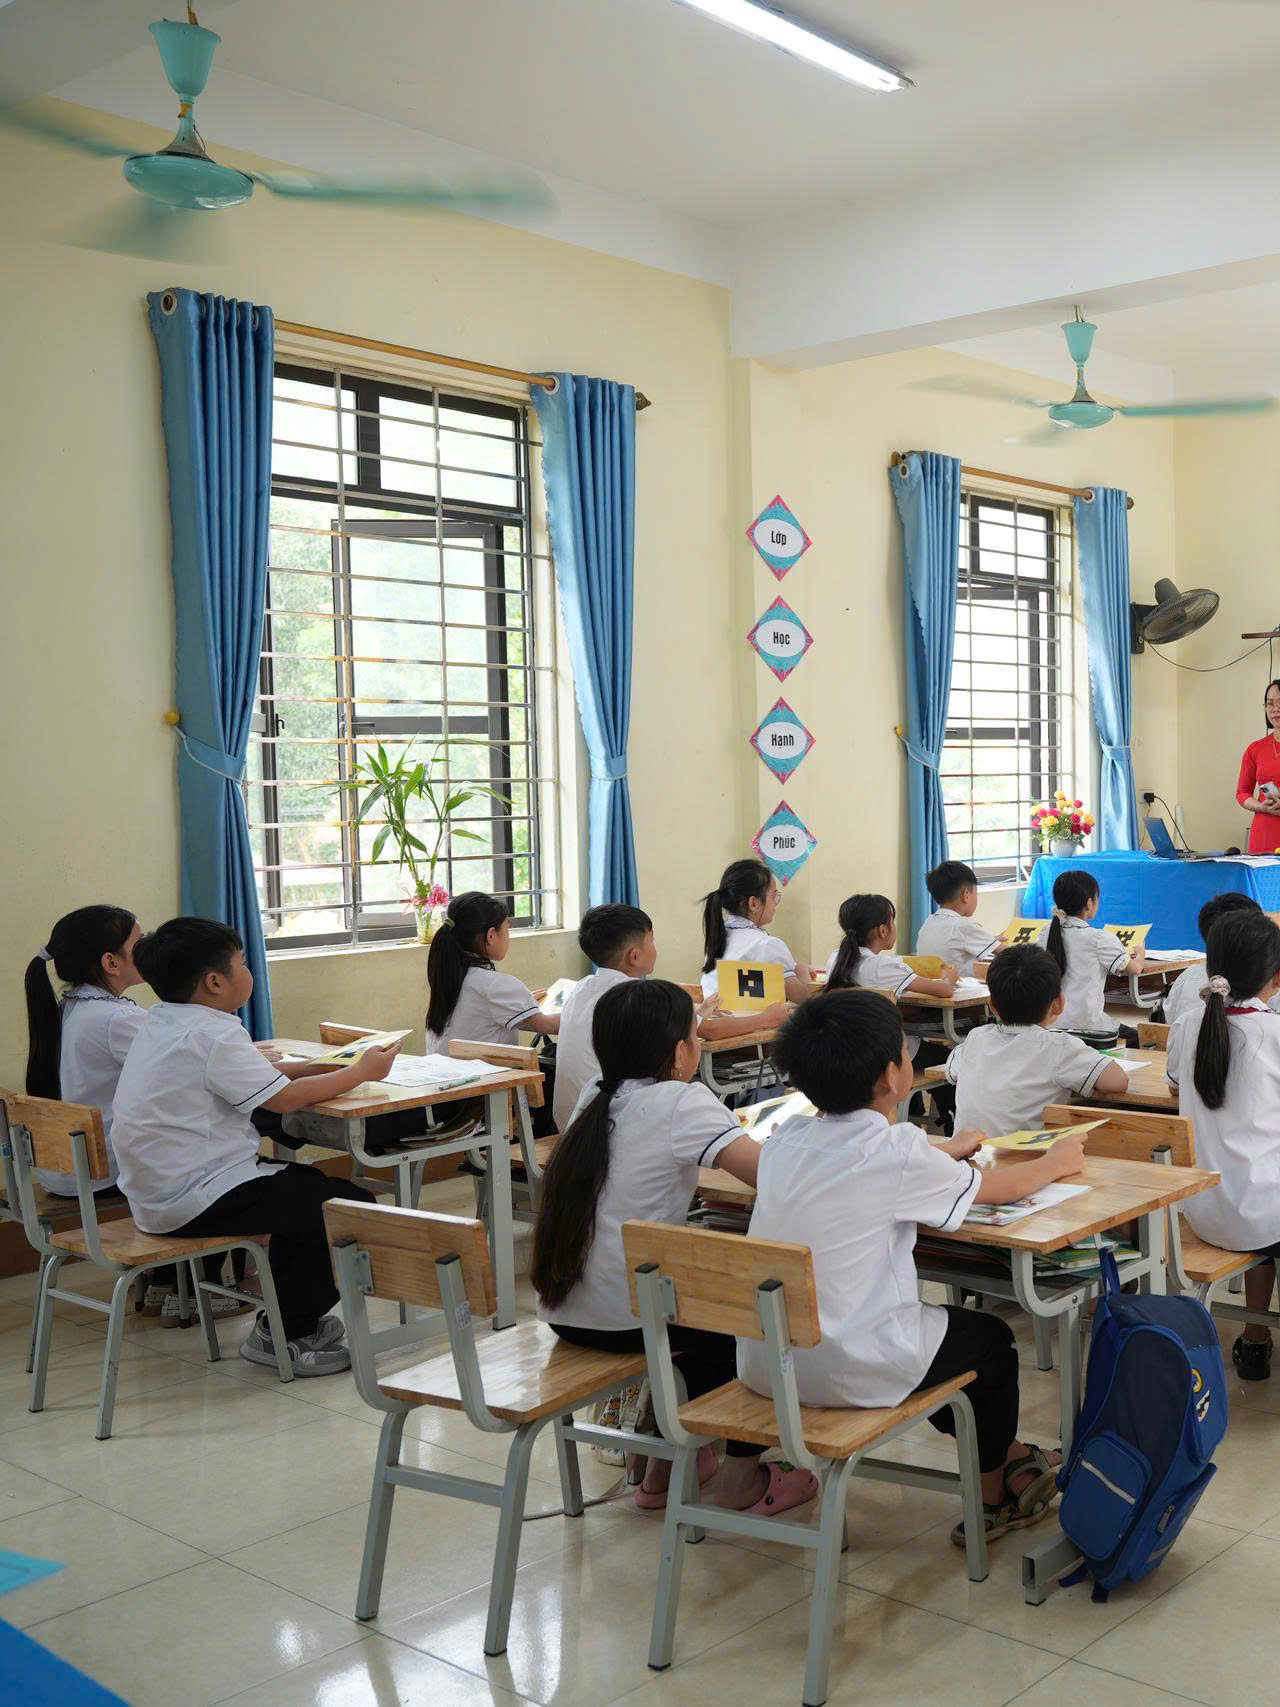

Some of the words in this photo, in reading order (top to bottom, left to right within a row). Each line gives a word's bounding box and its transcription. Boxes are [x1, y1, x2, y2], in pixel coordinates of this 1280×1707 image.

[770, 530, 787, 546] Lớp
[773, 631, 790, 647] Học
[771, 733, 795, 749] Hạnh
[773, 835, 796, 849] Phúc
